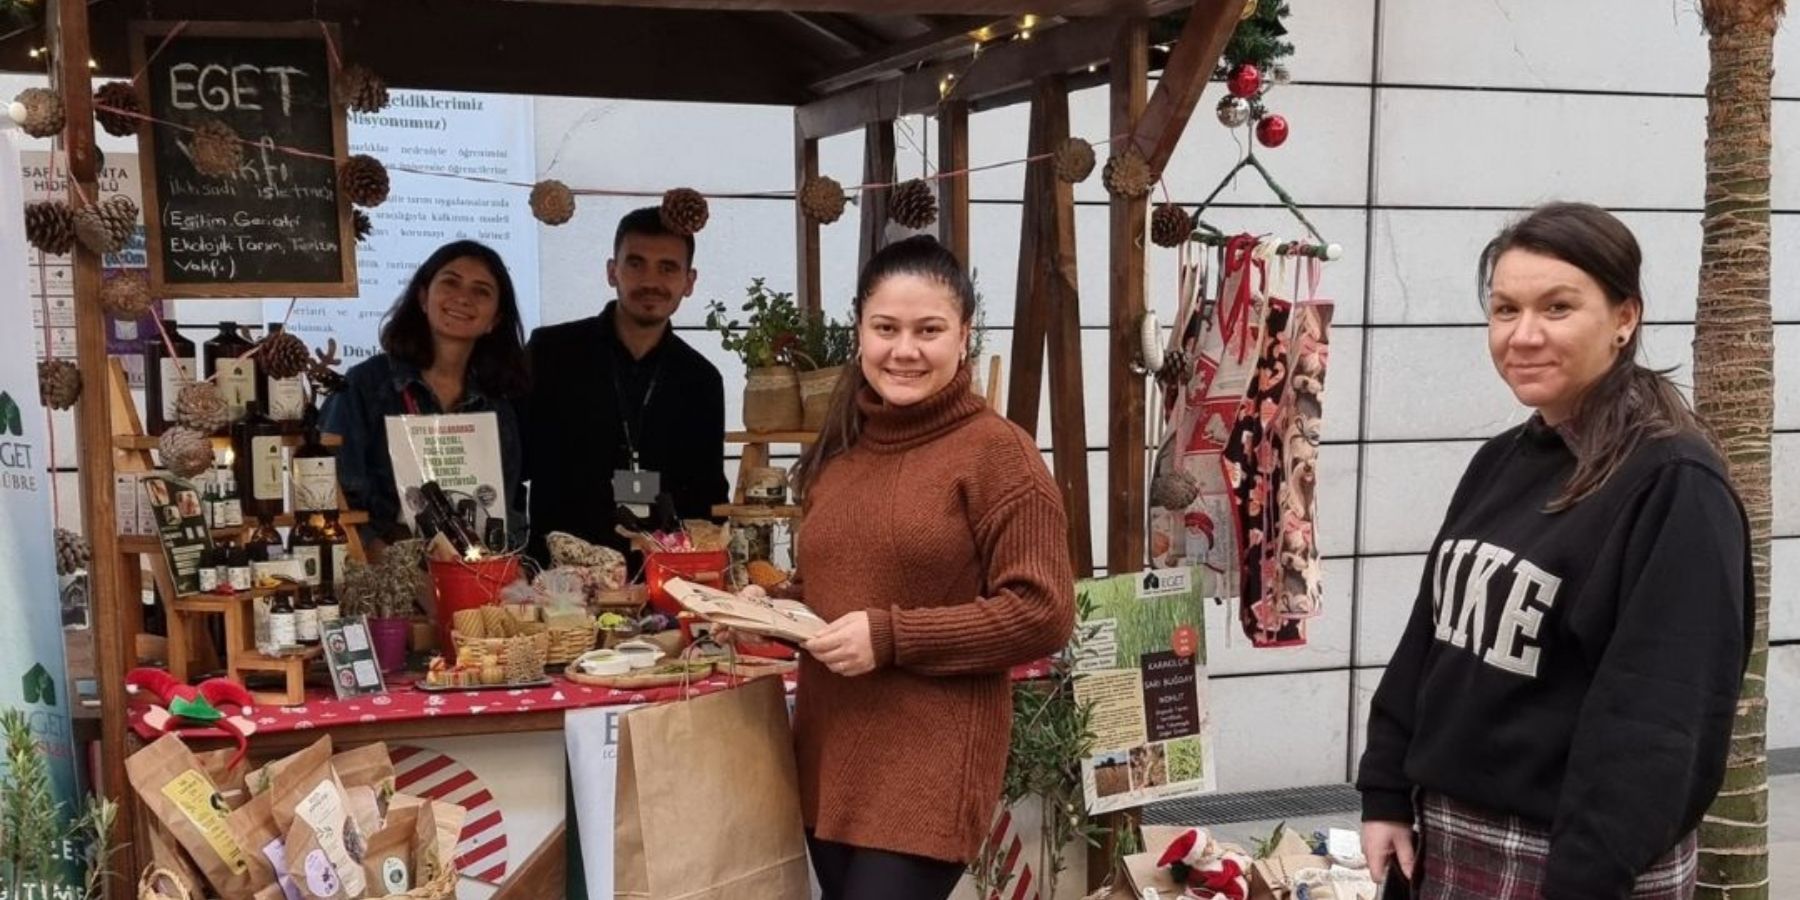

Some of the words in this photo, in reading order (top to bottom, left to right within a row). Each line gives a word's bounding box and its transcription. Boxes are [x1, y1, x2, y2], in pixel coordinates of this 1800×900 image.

[170, 63, 308, 116] EGET
[387, 94, 484, 111] eldiklerimiz
[56, 167, 128, 180] LNTA
[0, 441, 32, 469] GET
[1, 471, 38, 492] ÜBRE
